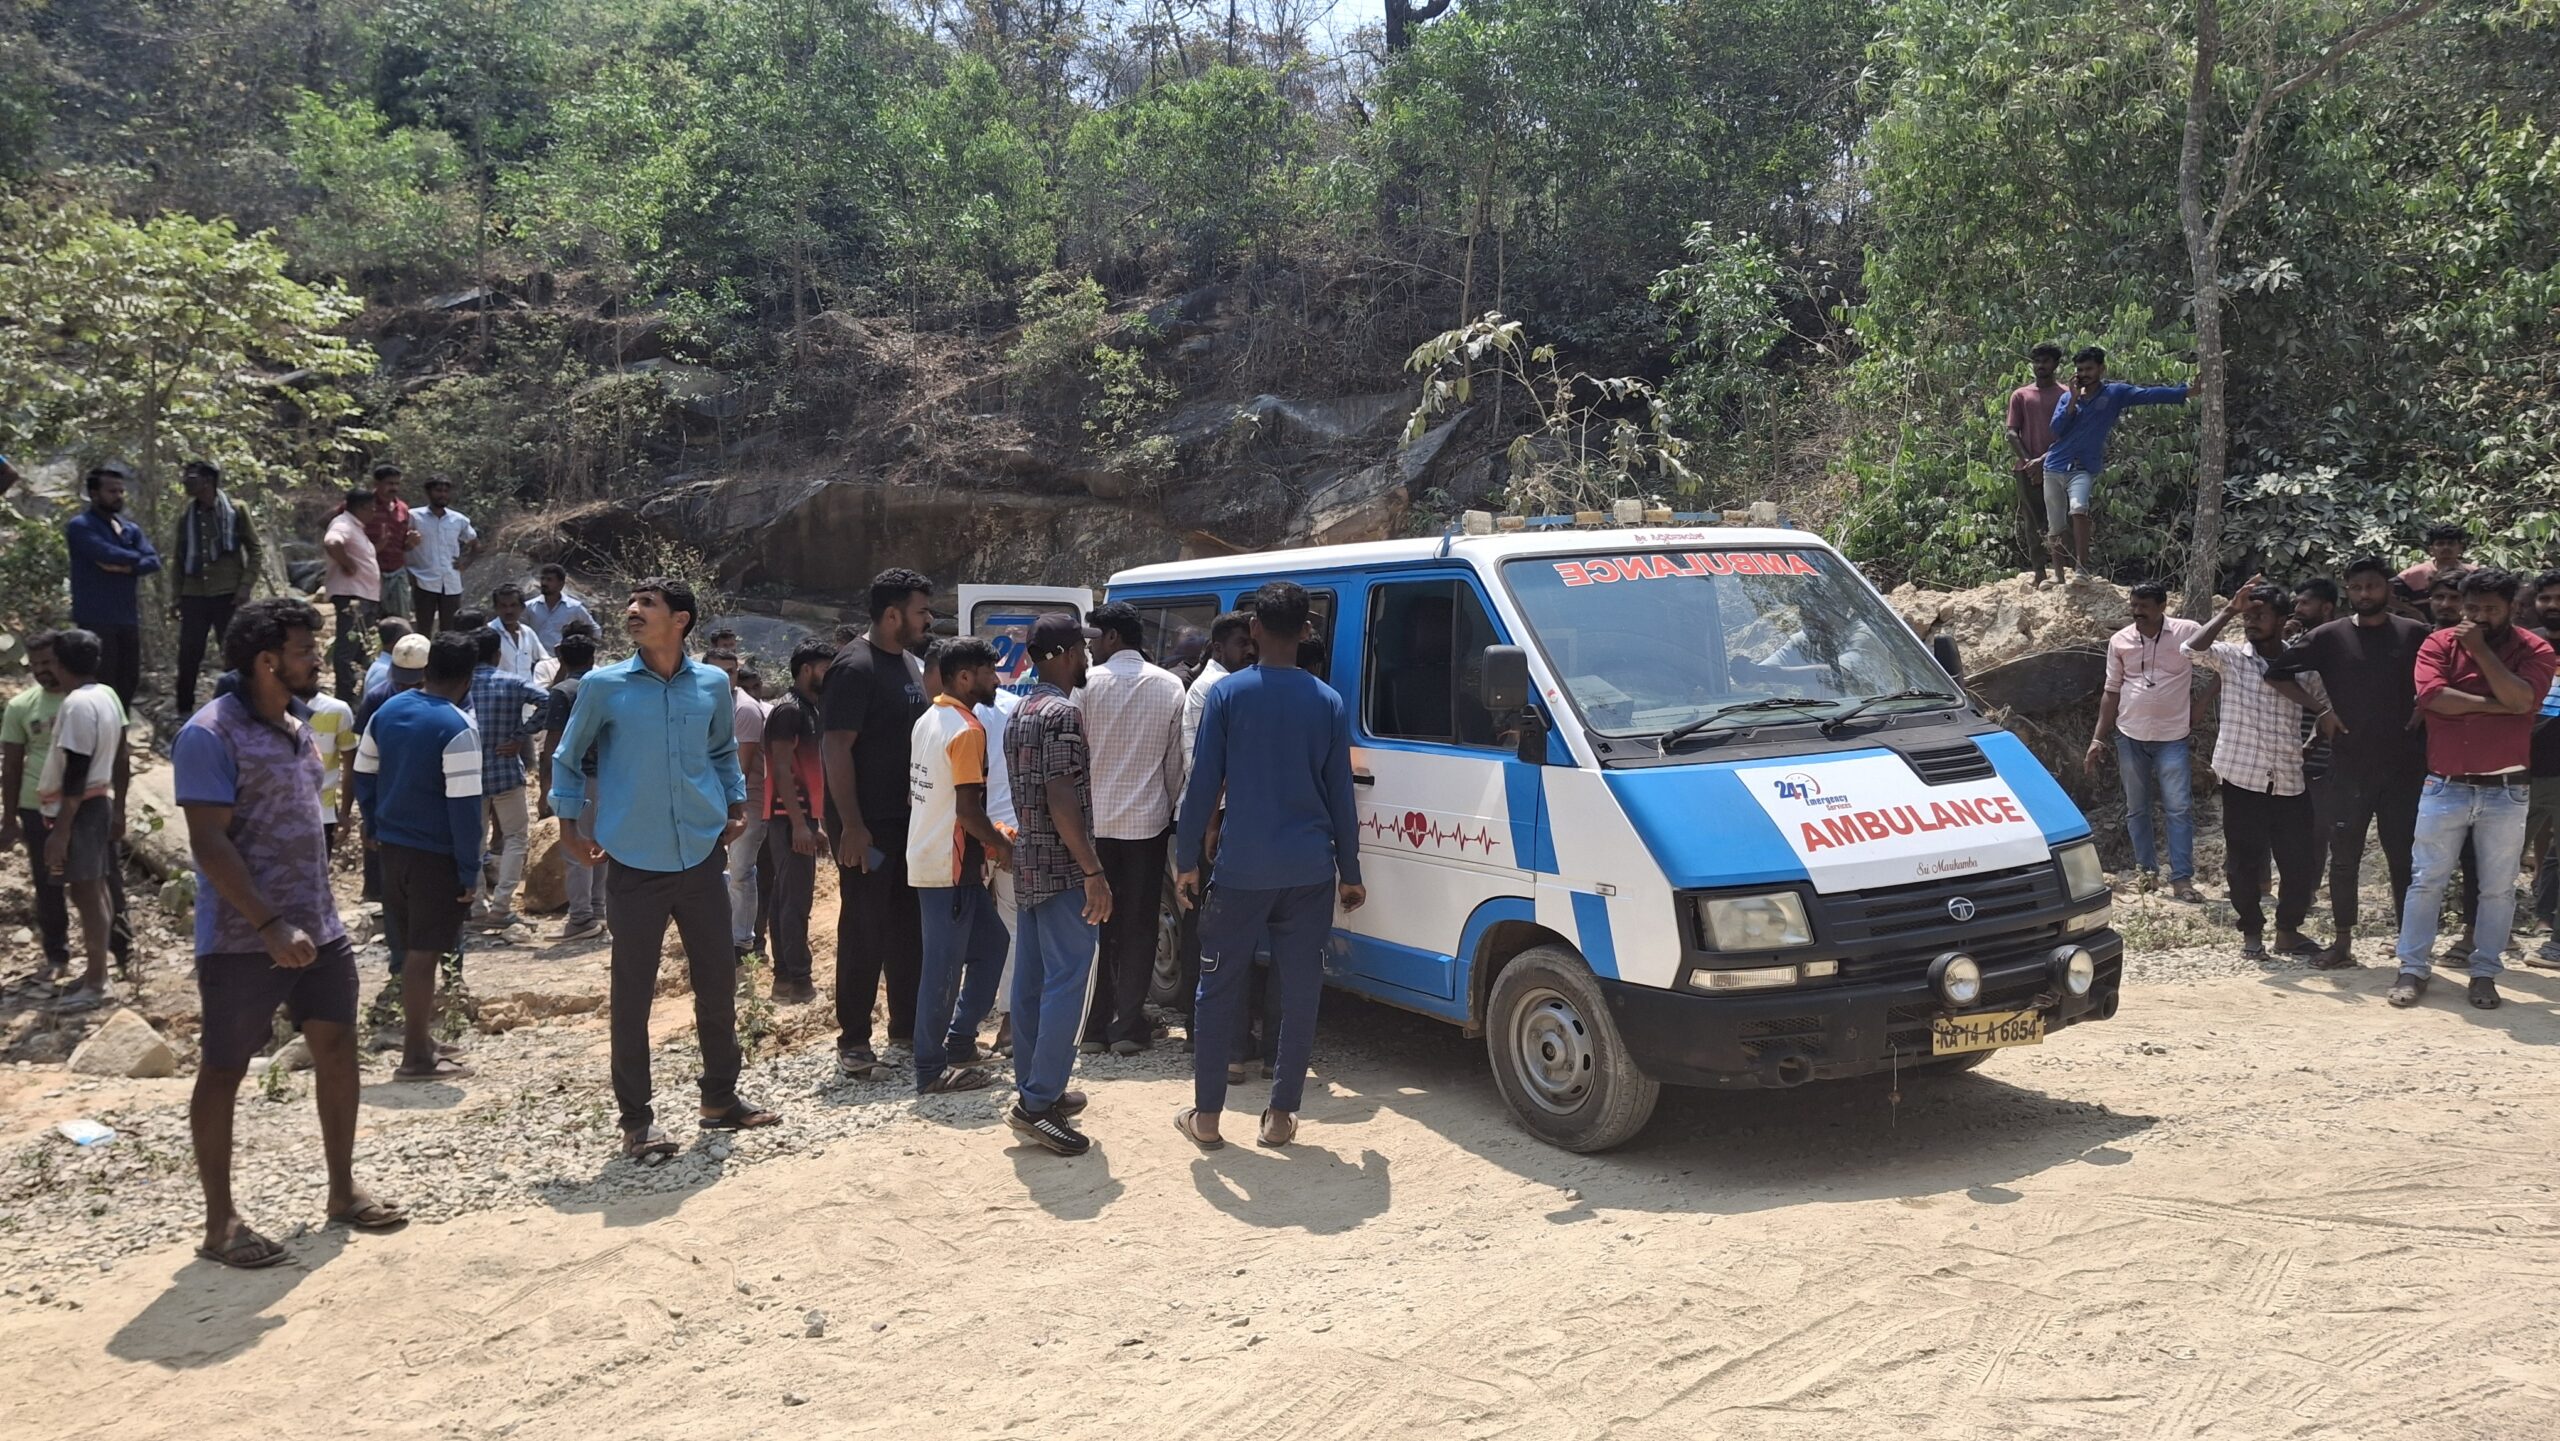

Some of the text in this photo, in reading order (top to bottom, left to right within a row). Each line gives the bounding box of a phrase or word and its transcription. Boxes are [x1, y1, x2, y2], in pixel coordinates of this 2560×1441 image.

[1805, 795, 1848, 806] Emergency
[1826, 803, 1852, 811] Services
[1800, 797, 2025, 852] AMBULANCE
[1916, 862, 1930, 876] Sri
[1940, 1019, 2037, 1048] KA 14 A 6854
